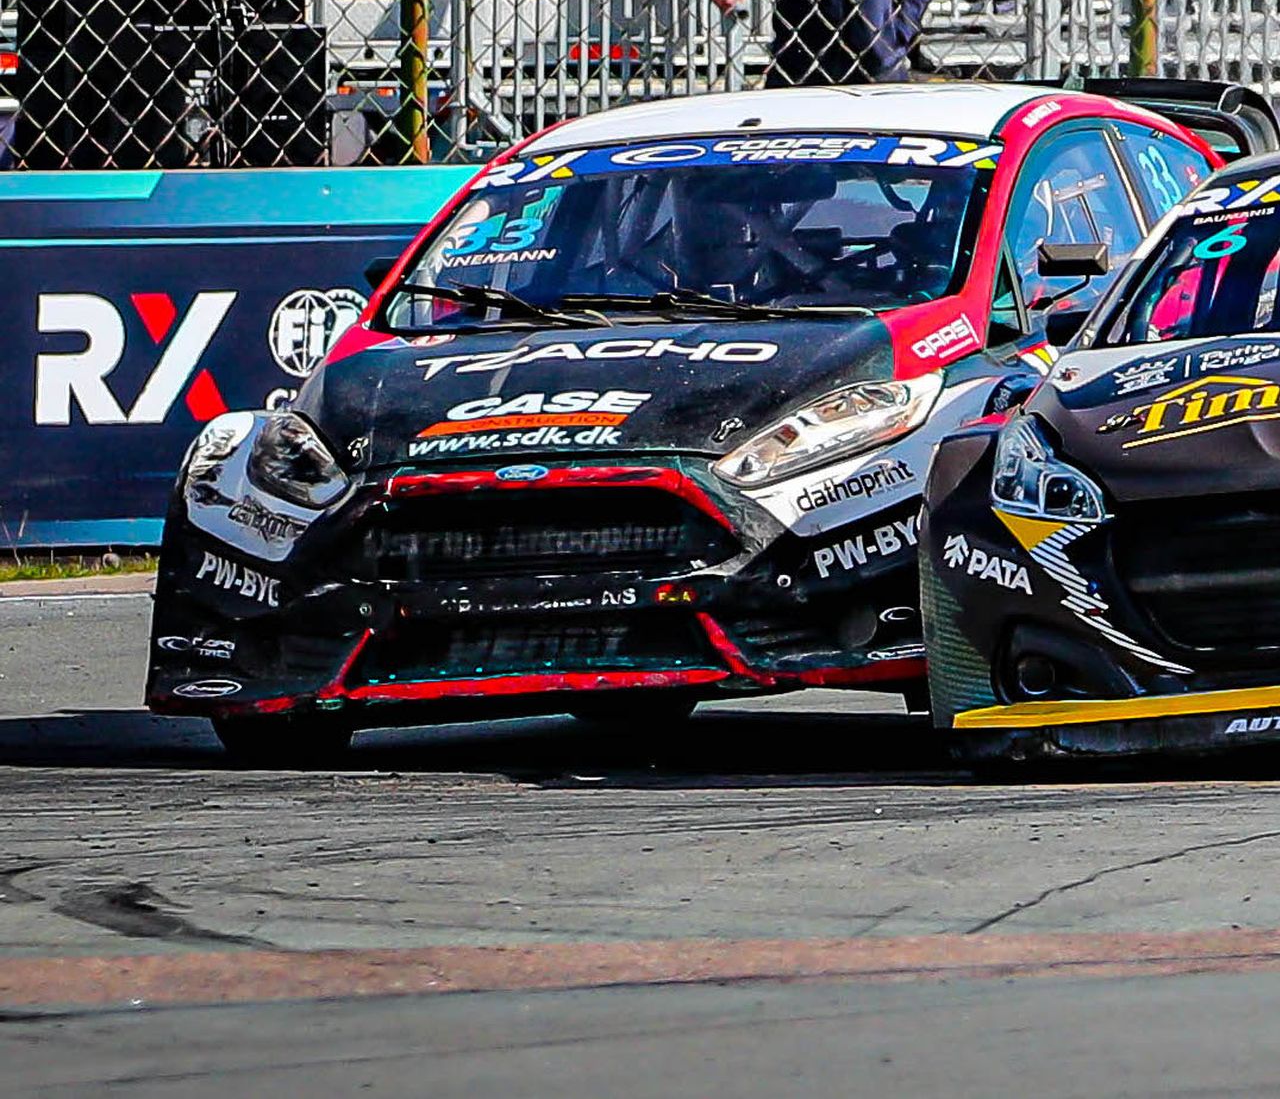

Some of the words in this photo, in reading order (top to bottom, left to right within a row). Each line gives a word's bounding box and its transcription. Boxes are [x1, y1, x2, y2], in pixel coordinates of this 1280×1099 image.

[713, 138, 876, 153] COOPER
[728, 148, 847, 162] TIRES
[887, 136, 1004, 170] RX
[1193, 207, 1275, 226] BAUMANIS
[1193, 222, 1249, 259] 6
[36, 290, 238, 426] RX
[415, 339, 778, 381] TZACHO
[447, 390, 651, 421] CASE
[457, 415, 617, 433] CONSTRUCTION
[408, 426, 623, 457] www.sdk.dk
[797, 460, 915, 513] dathoprint
[814, 514, 925, 580] PW-BY
[966, 549, 1034, 596] PATA
